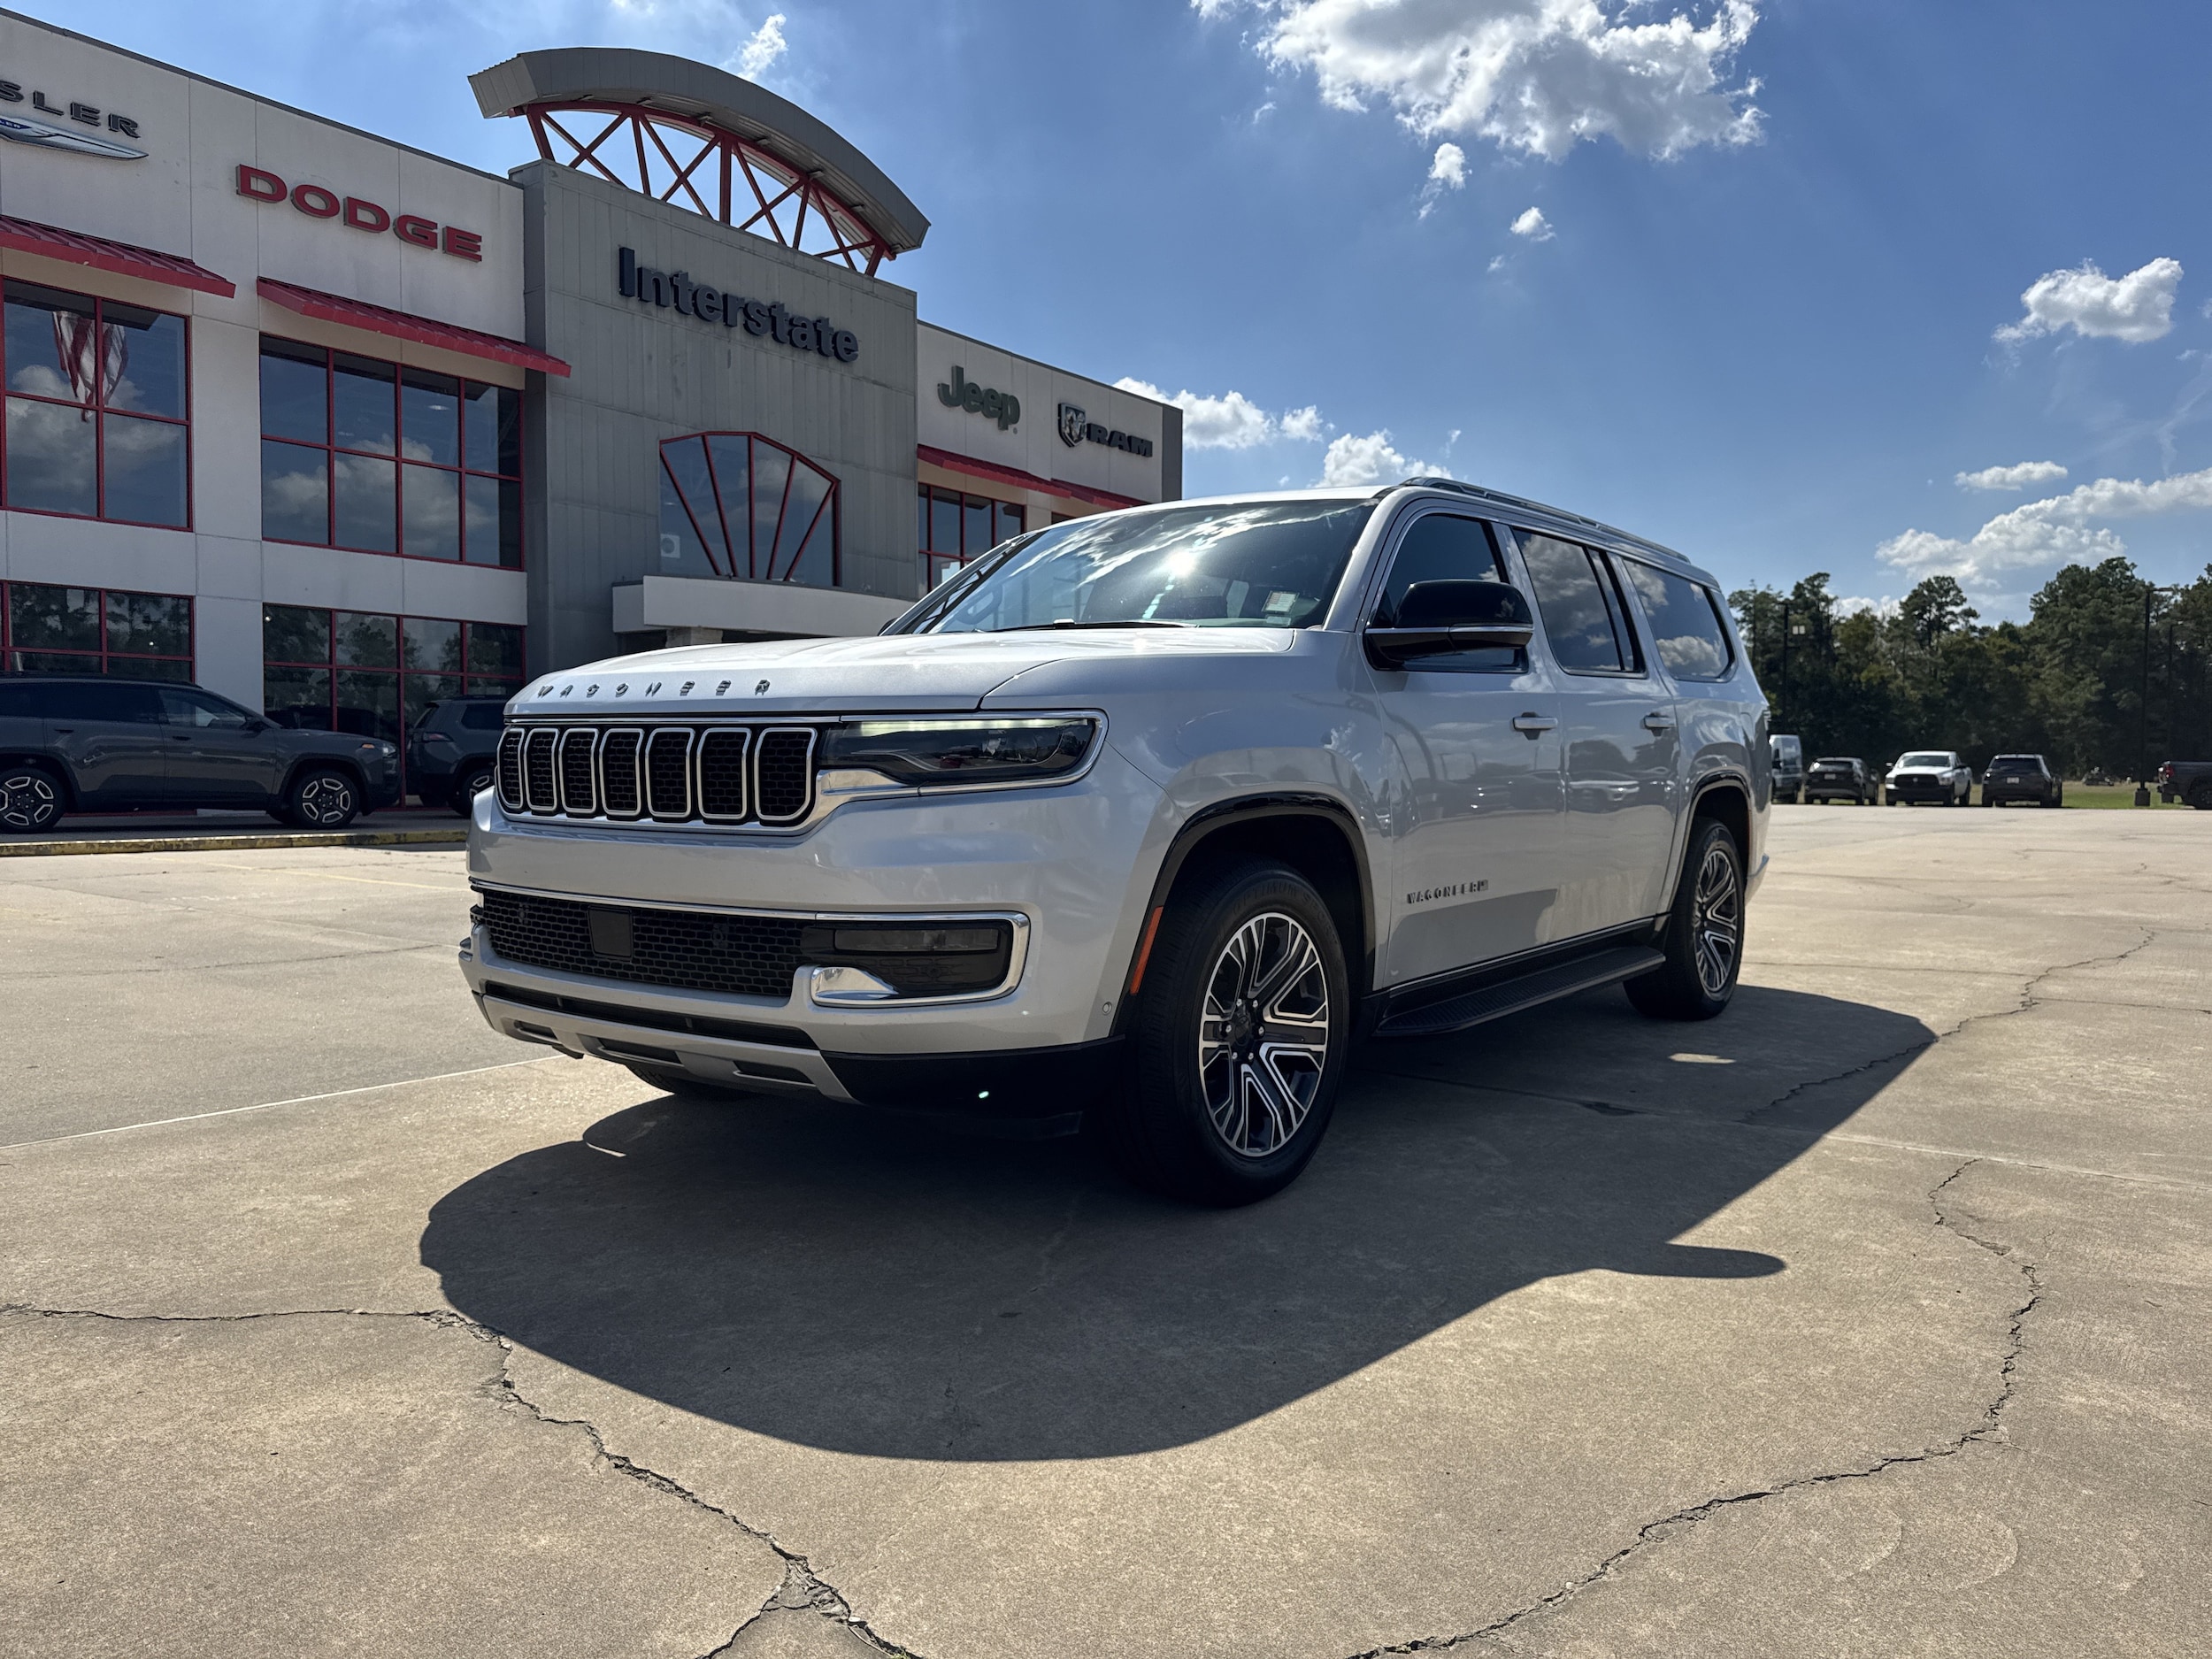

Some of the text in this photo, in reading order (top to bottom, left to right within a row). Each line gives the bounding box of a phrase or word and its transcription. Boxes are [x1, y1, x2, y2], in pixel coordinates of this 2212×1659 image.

[0, 80, 141, 139] SLER
[235, 164, 482, 263] DODGE
[618, 247, 859, 362] Interstate
[937, 365, 1021, 431] Jeep
[1086, 422, 1153, 457] RAM
[537, 679, 771, 699] WAGONEER
[1407, 881, 1477, 904] WAGONEER
